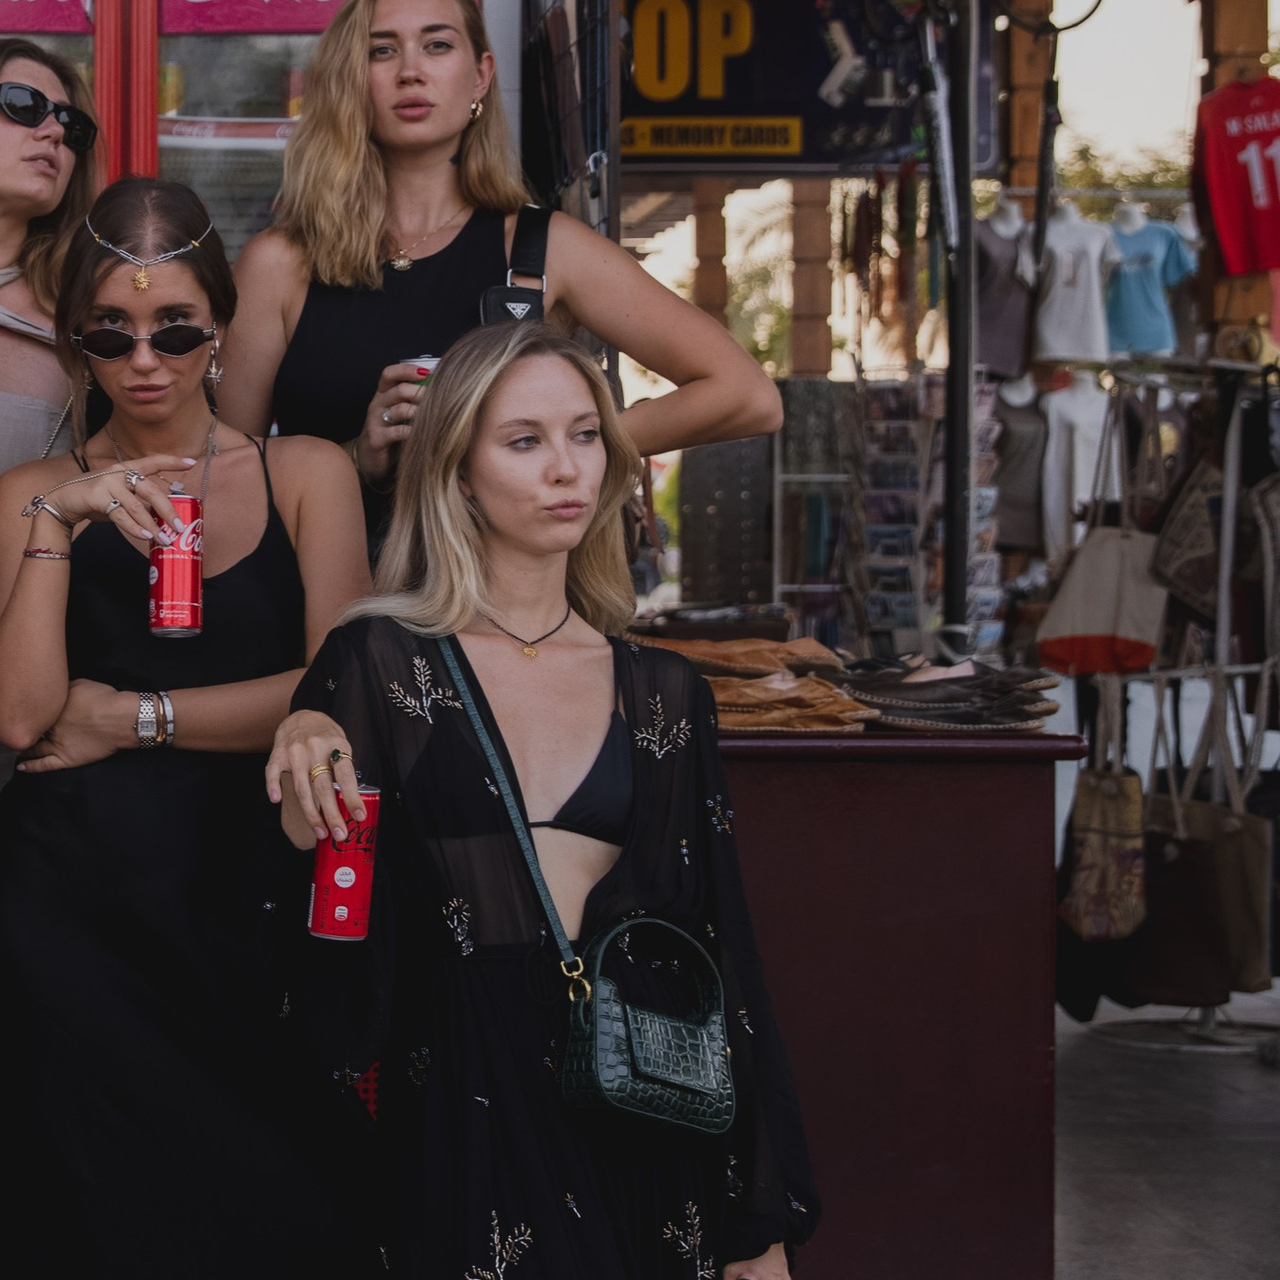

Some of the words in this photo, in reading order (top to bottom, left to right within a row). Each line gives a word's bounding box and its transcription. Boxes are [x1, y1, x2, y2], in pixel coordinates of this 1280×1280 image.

[650, 126, 724, 148] MEMORY
[730, 126, 790, 148] CARDS
[1236, 135, 1280, 211] 11
